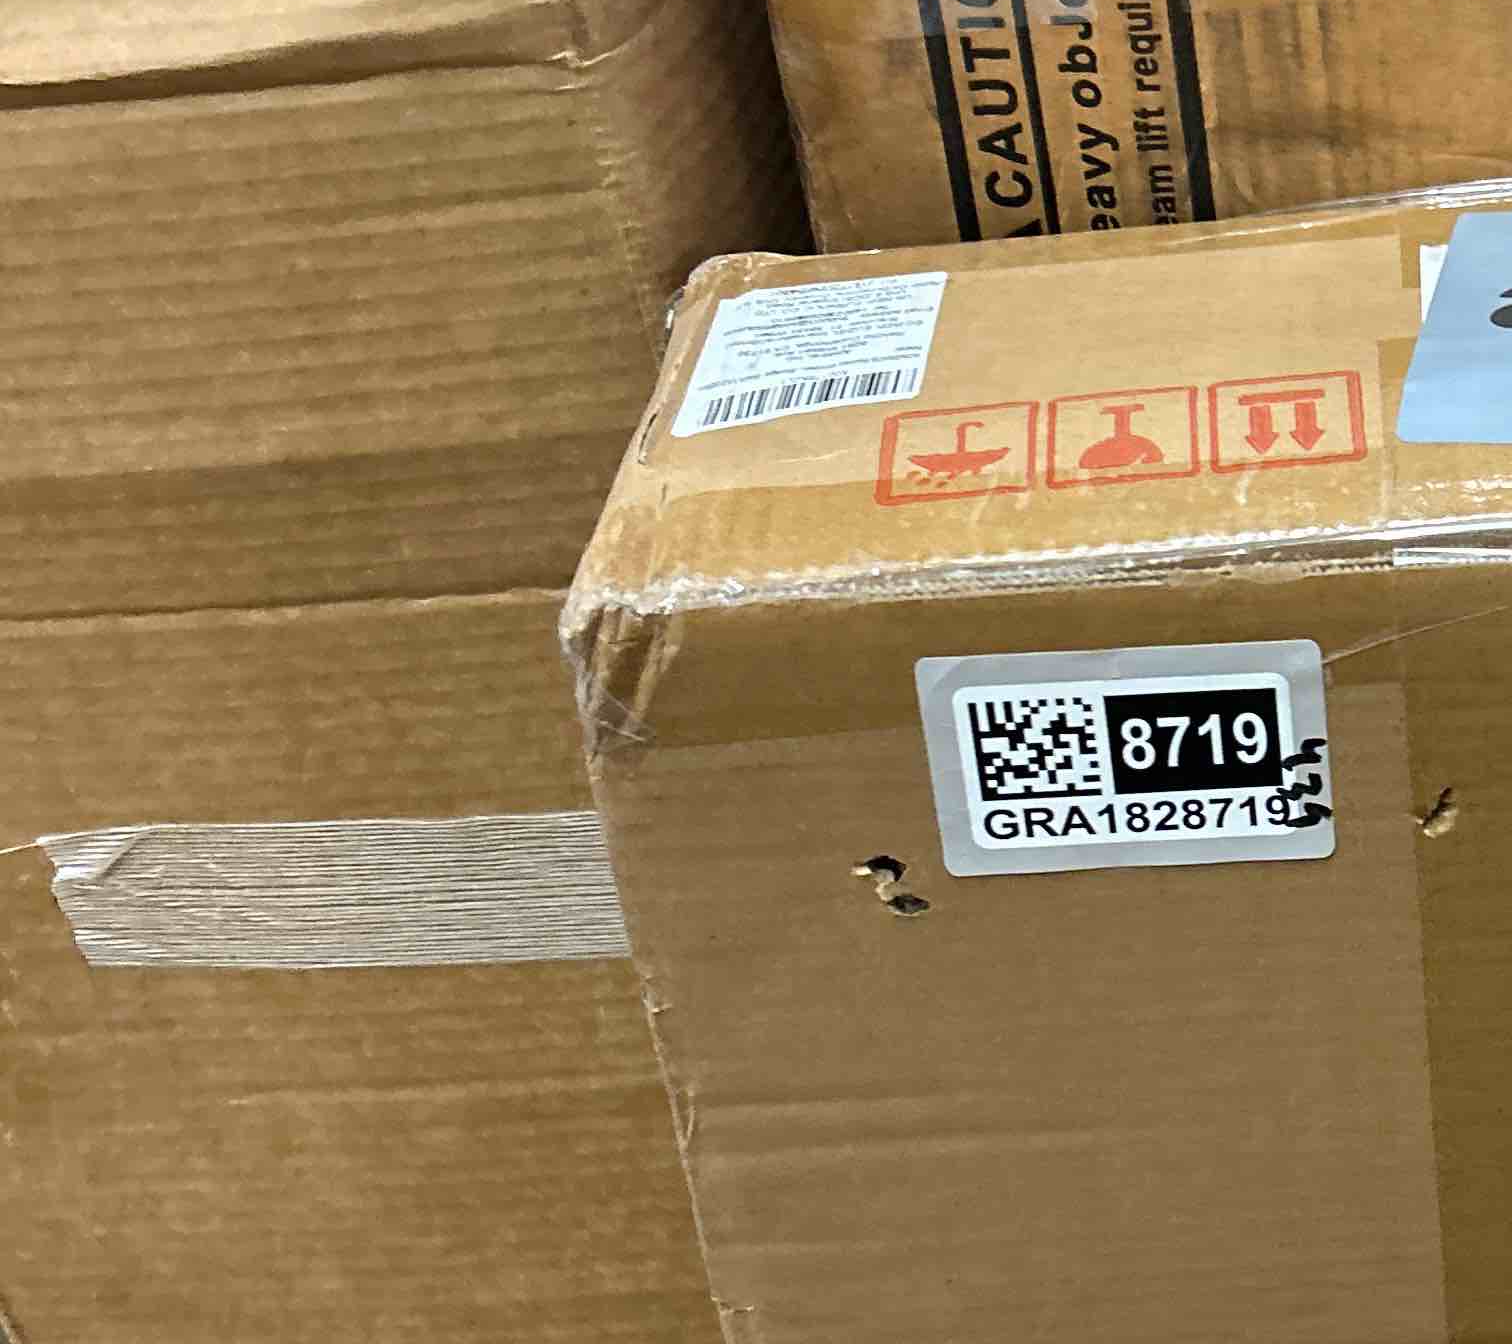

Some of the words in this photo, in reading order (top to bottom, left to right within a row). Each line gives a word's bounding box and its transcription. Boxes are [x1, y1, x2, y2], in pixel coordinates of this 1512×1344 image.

[1132, 107, 1169, 152] lift
[1077, 123, 1122, 232] eavy
[1149, 164, 1179, 226] eam
[1119, 711, 1268, 770] 8719
[982, 794, 1287, 840] GRA1828719
